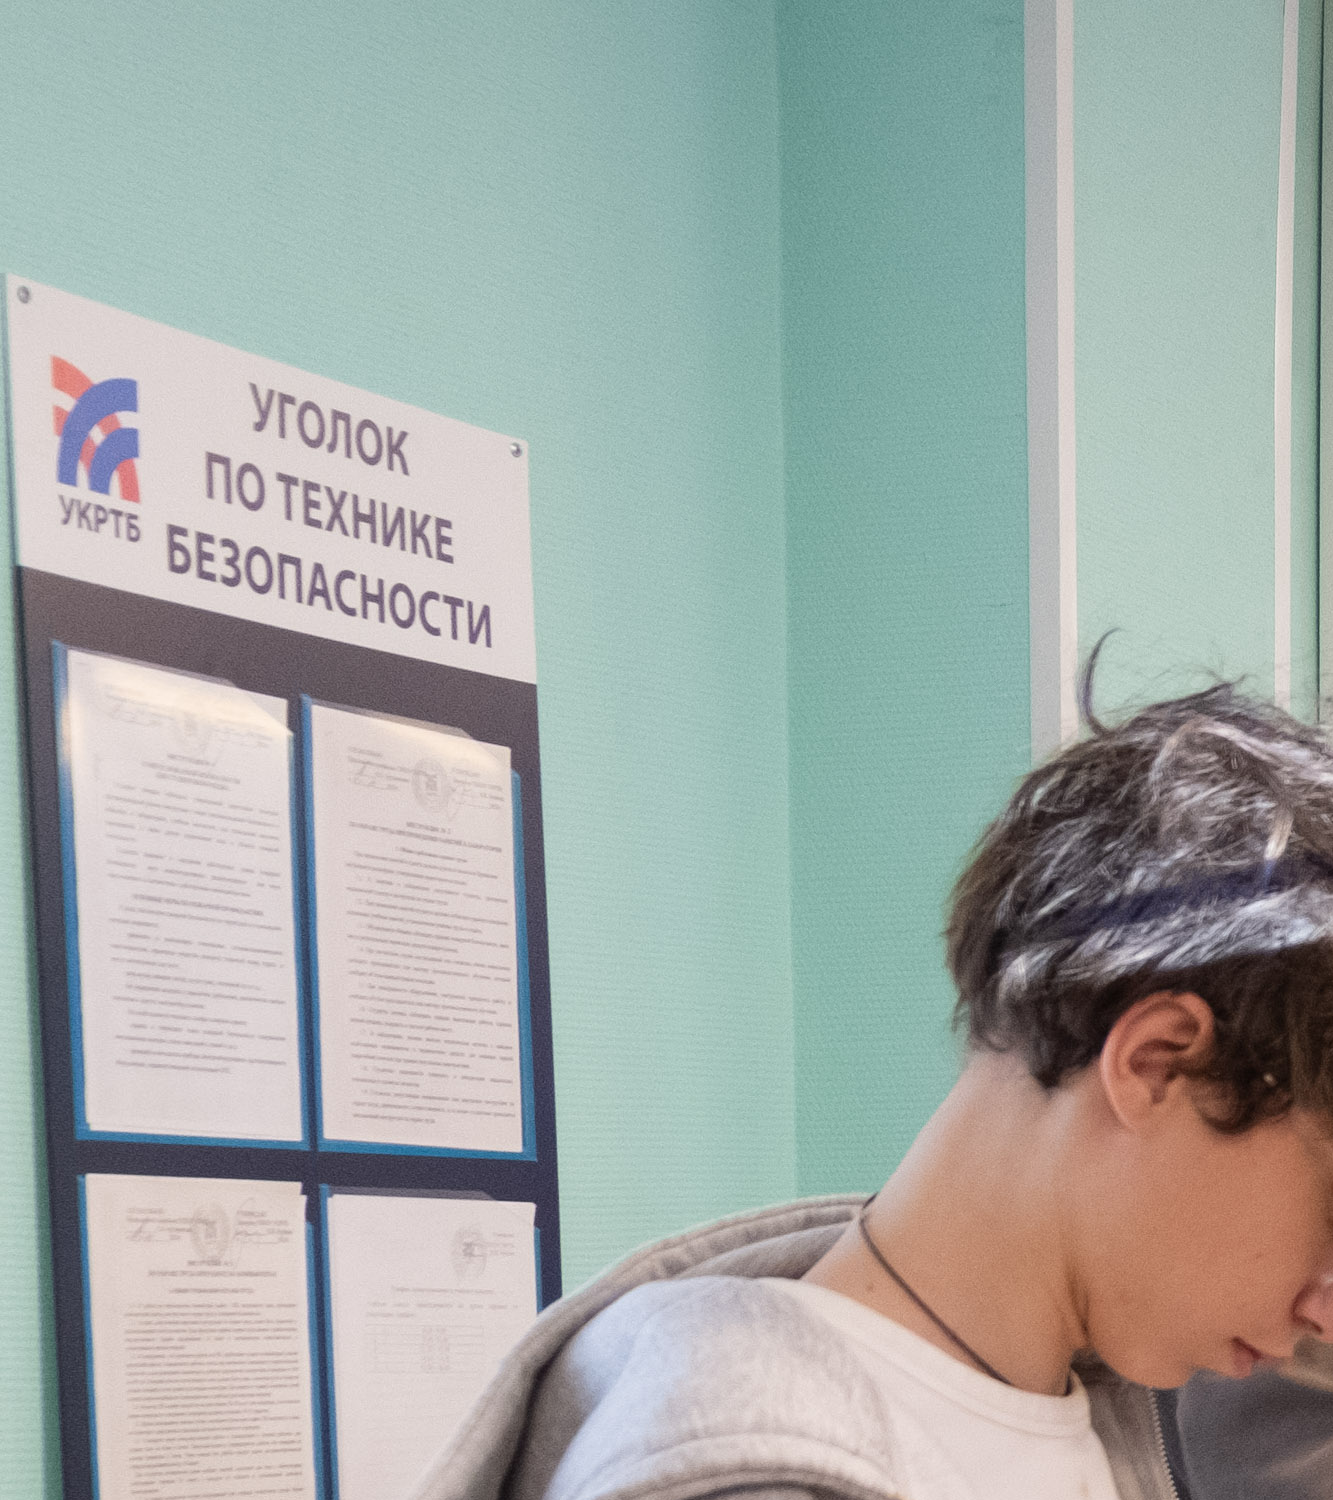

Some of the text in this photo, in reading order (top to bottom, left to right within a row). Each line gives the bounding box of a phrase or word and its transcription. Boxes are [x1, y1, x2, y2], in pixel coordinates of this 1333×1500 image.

[248, 382, 410, 476] УГОЛОК
[58, 494, 142, 543] УКРТБ
[205, 450, 455, 565] ПО ТЕХНИКЕ
[166, 523, 493, 649] БЕЗОПАСНОСТИ
